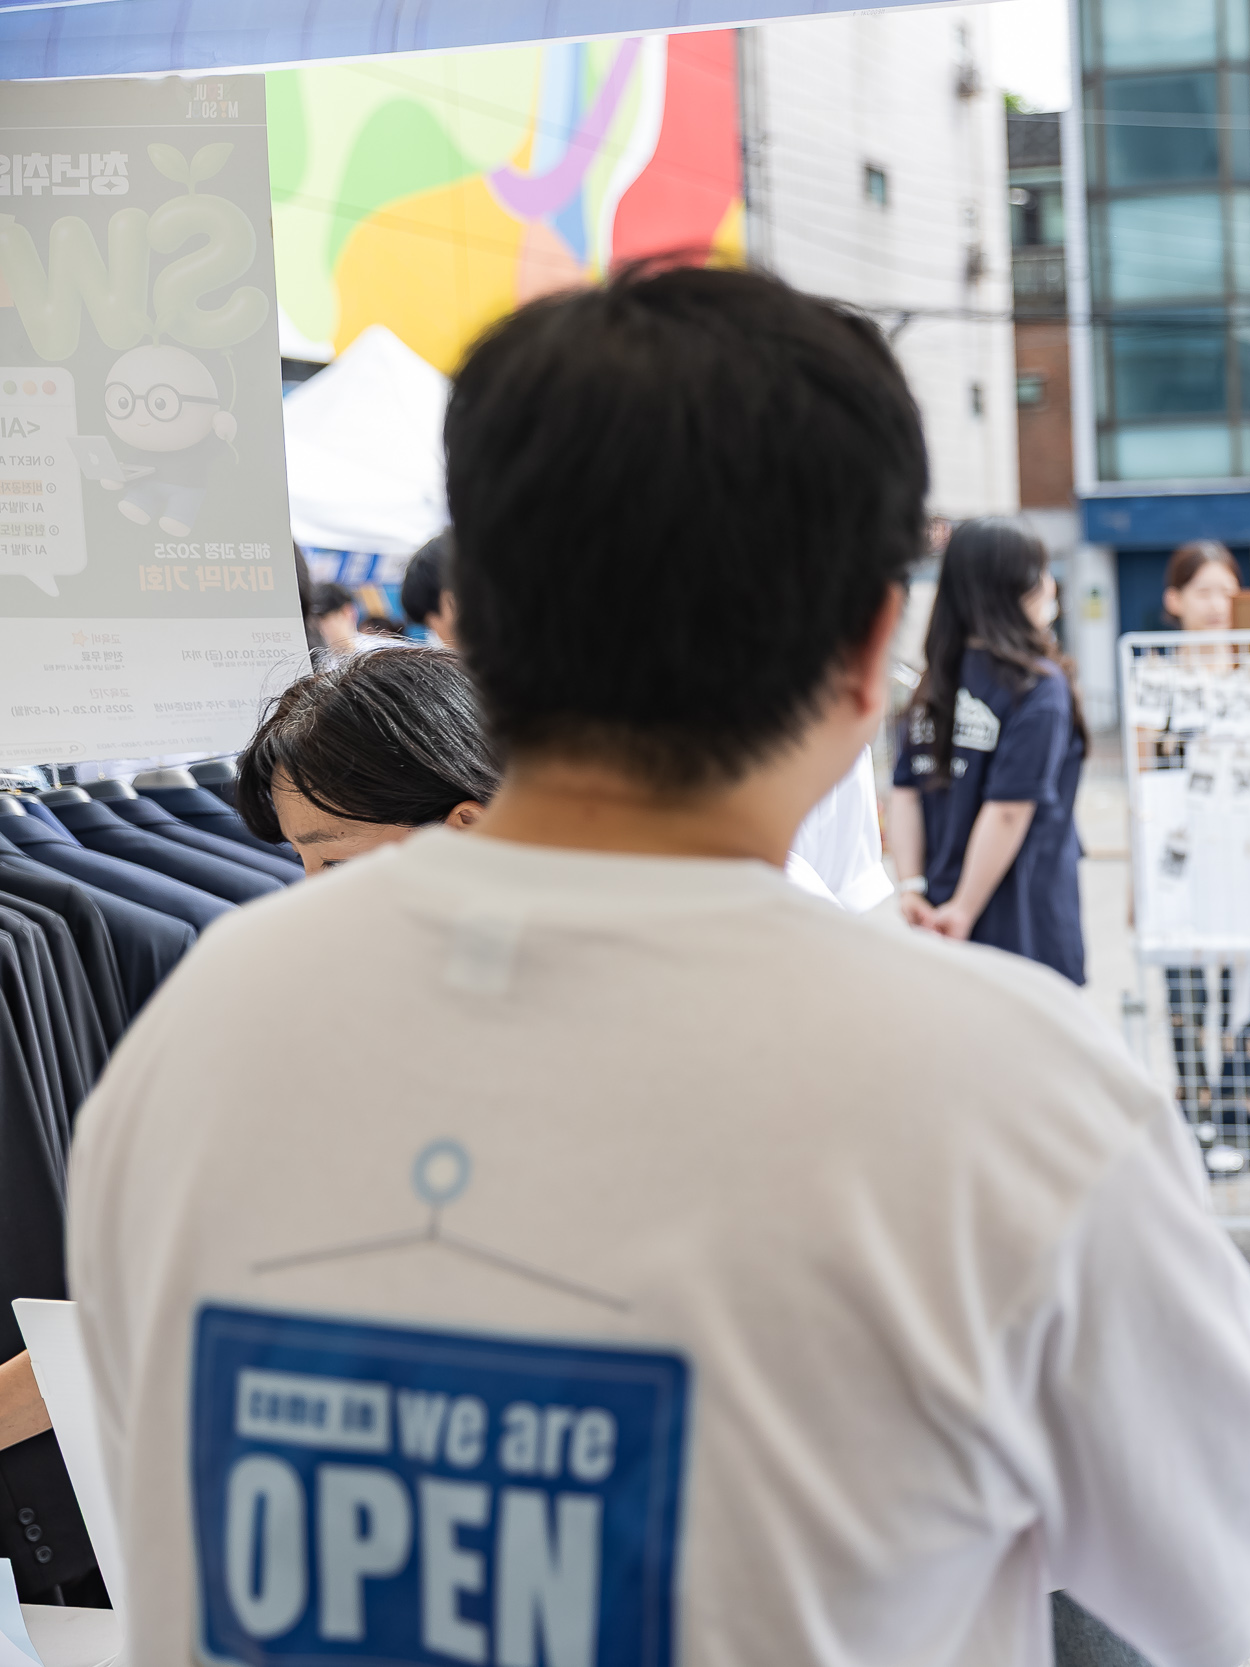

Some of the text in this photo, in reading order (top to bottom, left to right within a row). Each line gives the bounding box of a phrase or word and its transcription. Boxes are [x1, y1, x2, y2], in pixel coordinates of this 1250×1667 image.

[248, 1390, 375, 1432] come in
[397, 1387, 617, 1483] we are
[225, 1453, 604, 1667] OPEN
